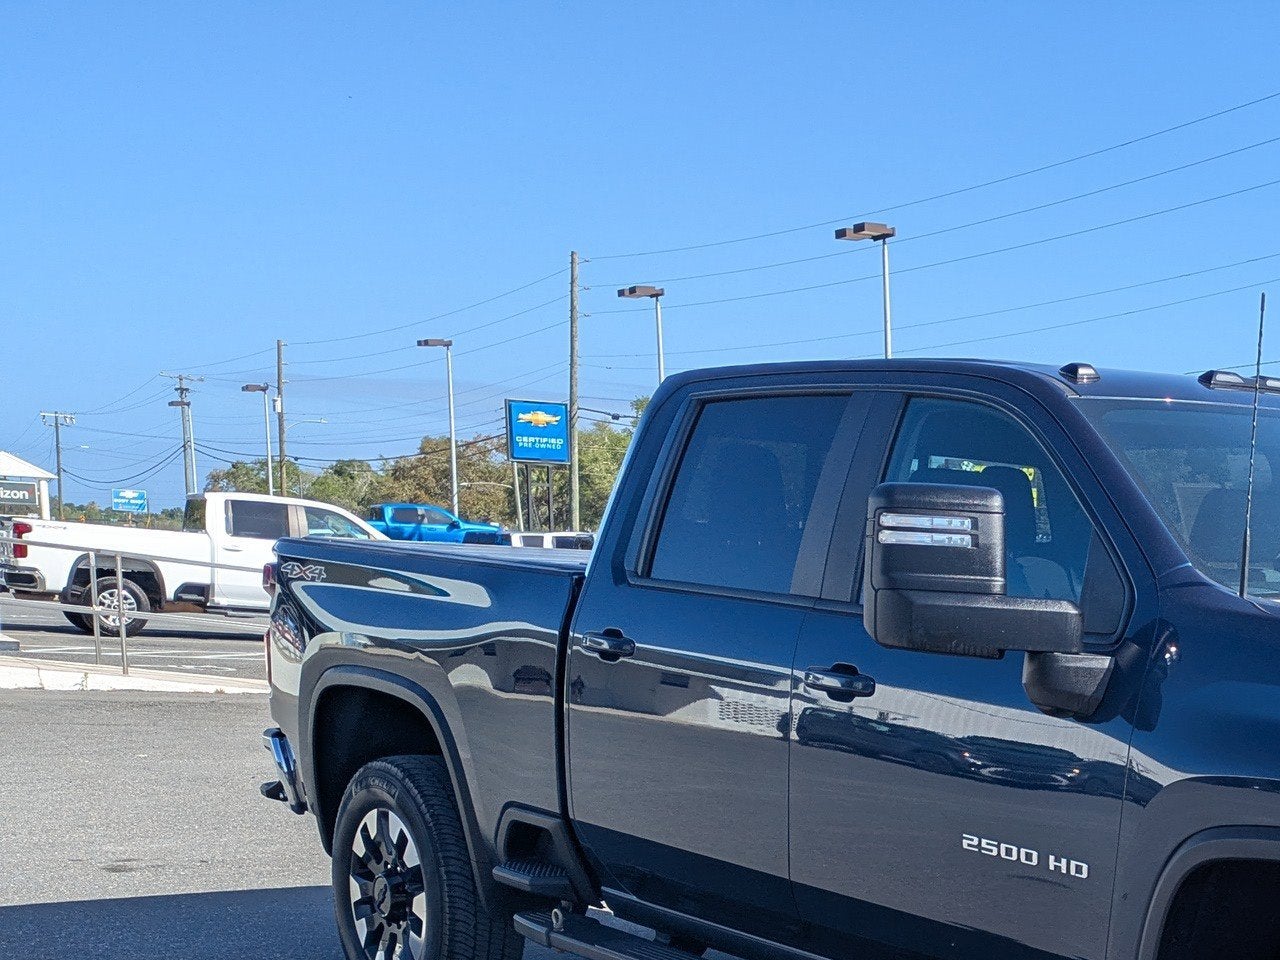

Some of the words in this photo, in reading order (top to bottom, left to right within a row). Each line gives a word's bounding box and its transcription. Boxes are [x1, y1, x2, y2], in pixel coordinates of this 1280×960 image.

[515, 436, 564, 444] CERTIFIED
[518, 442, 562, 450] PRE-OWNED
[962, 833, 1038, 866] 2500
[1048, 854, 1089, 879] HD
